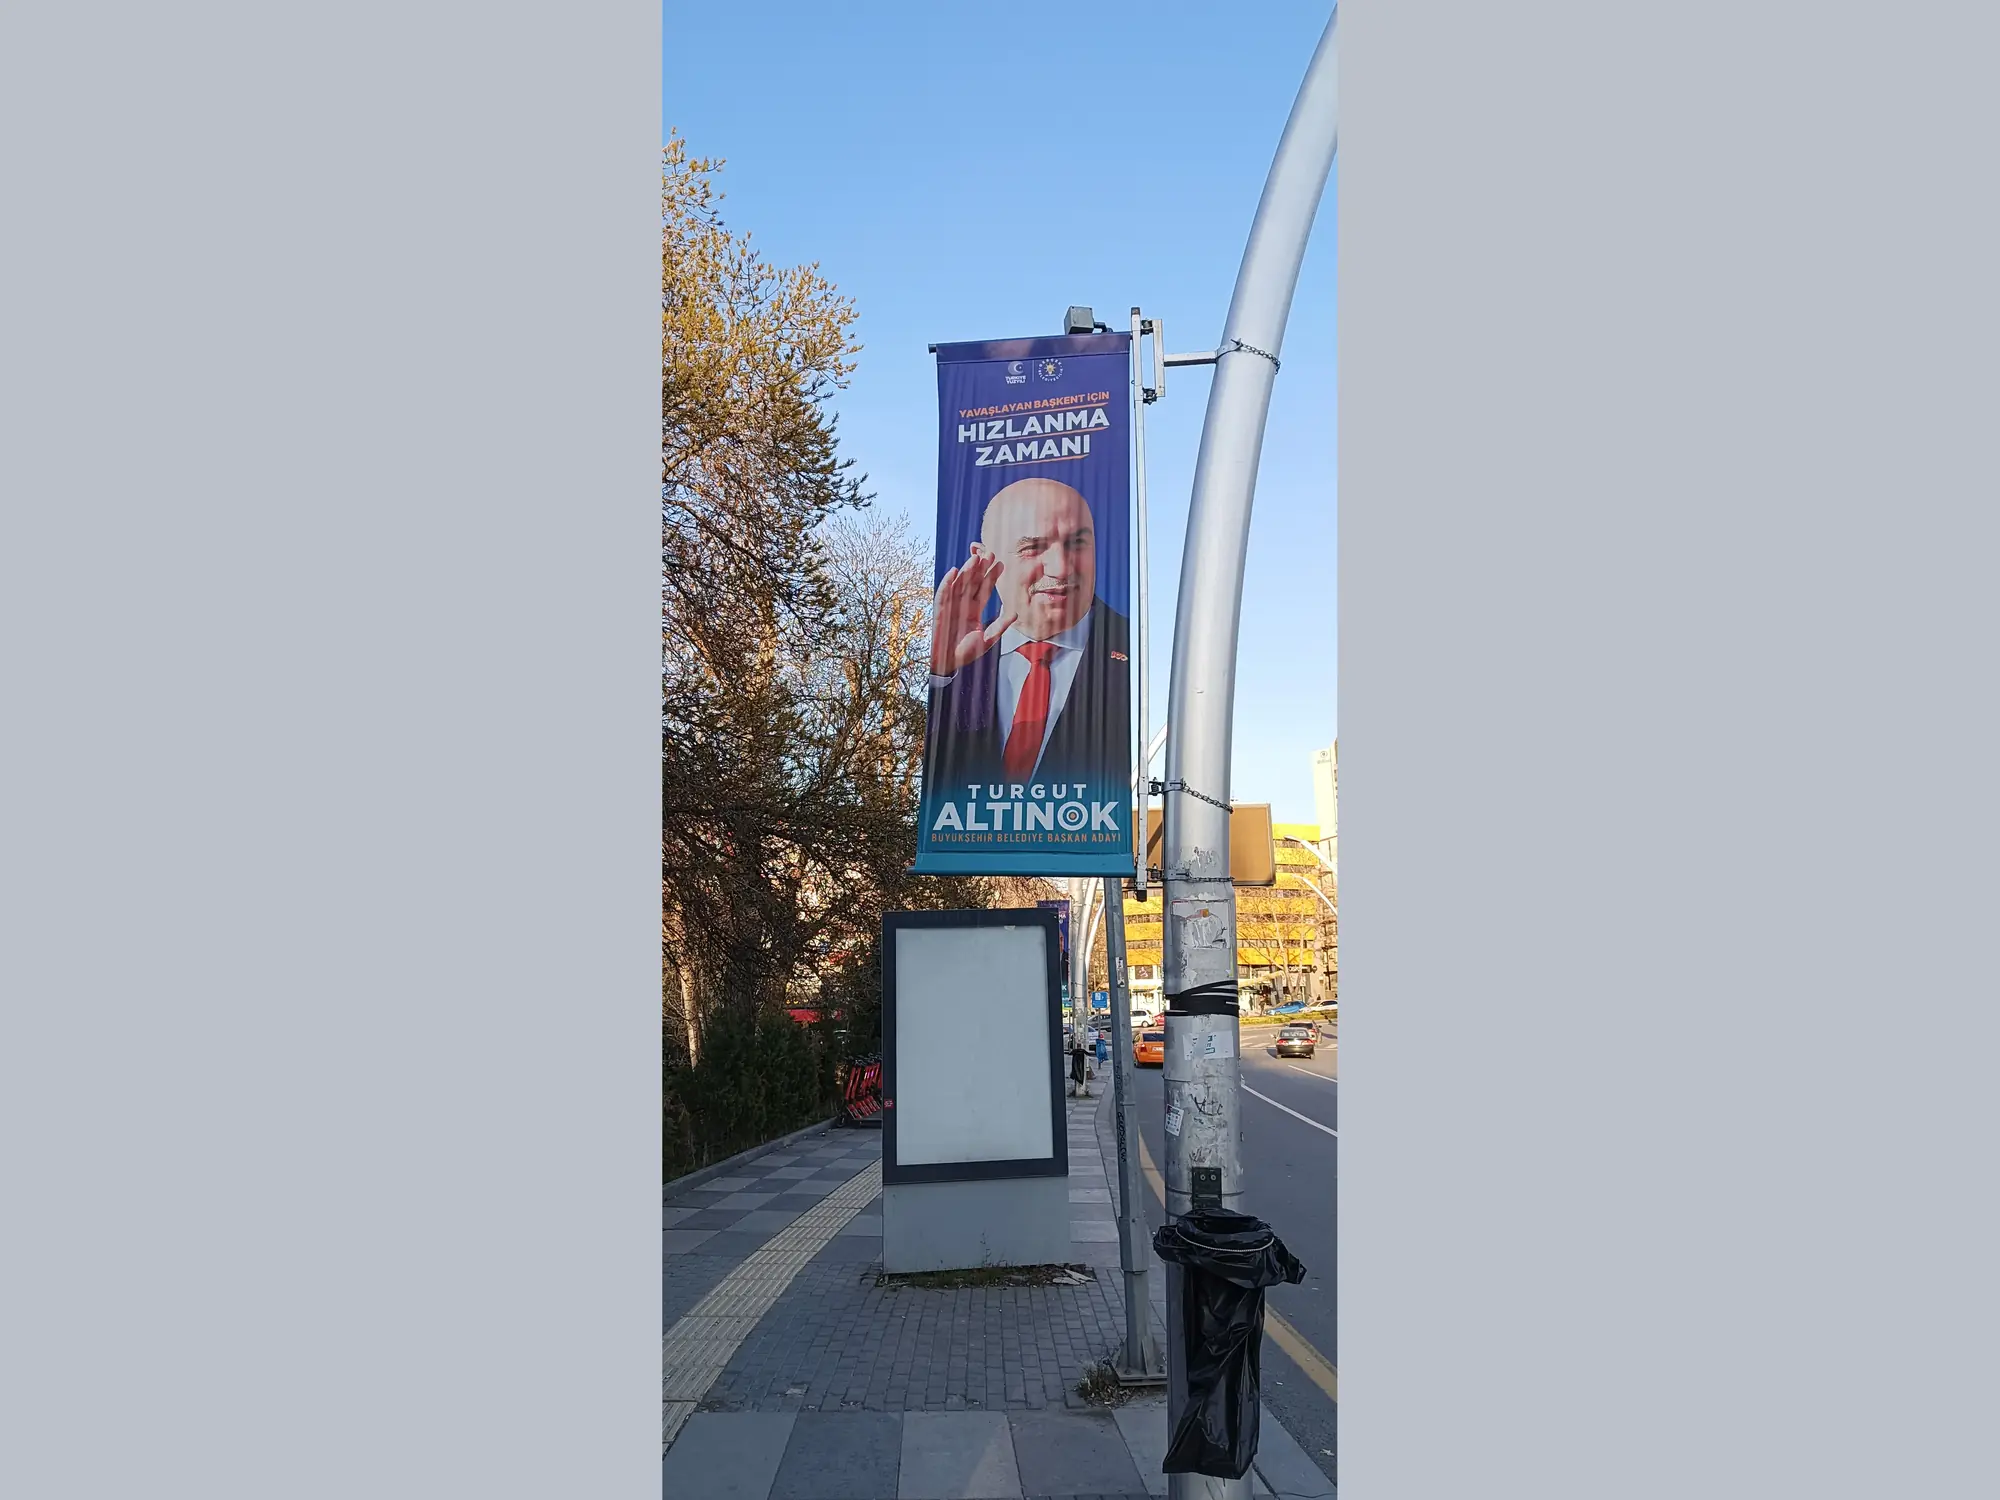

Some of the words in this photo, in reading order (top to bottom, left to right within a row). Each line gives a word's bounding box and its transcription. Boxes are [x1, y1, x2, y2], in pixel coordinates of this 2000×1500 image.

[959, 401, 1032, 418] YAVAŞLAYAN
[1034, 394, 1085, 409] BAŞKENT
[1087, 391, 1110, 404] İÇİN
[958, 408, 1110, 443] HIZLANMA
[975, 434, 1090, 467] ZAMANI
[967, 783, 1087, 800] TURGUT
[932, 801, 1120, 831] ALTINOK
[1047, 832, 1088, 843] BAŞKAN
